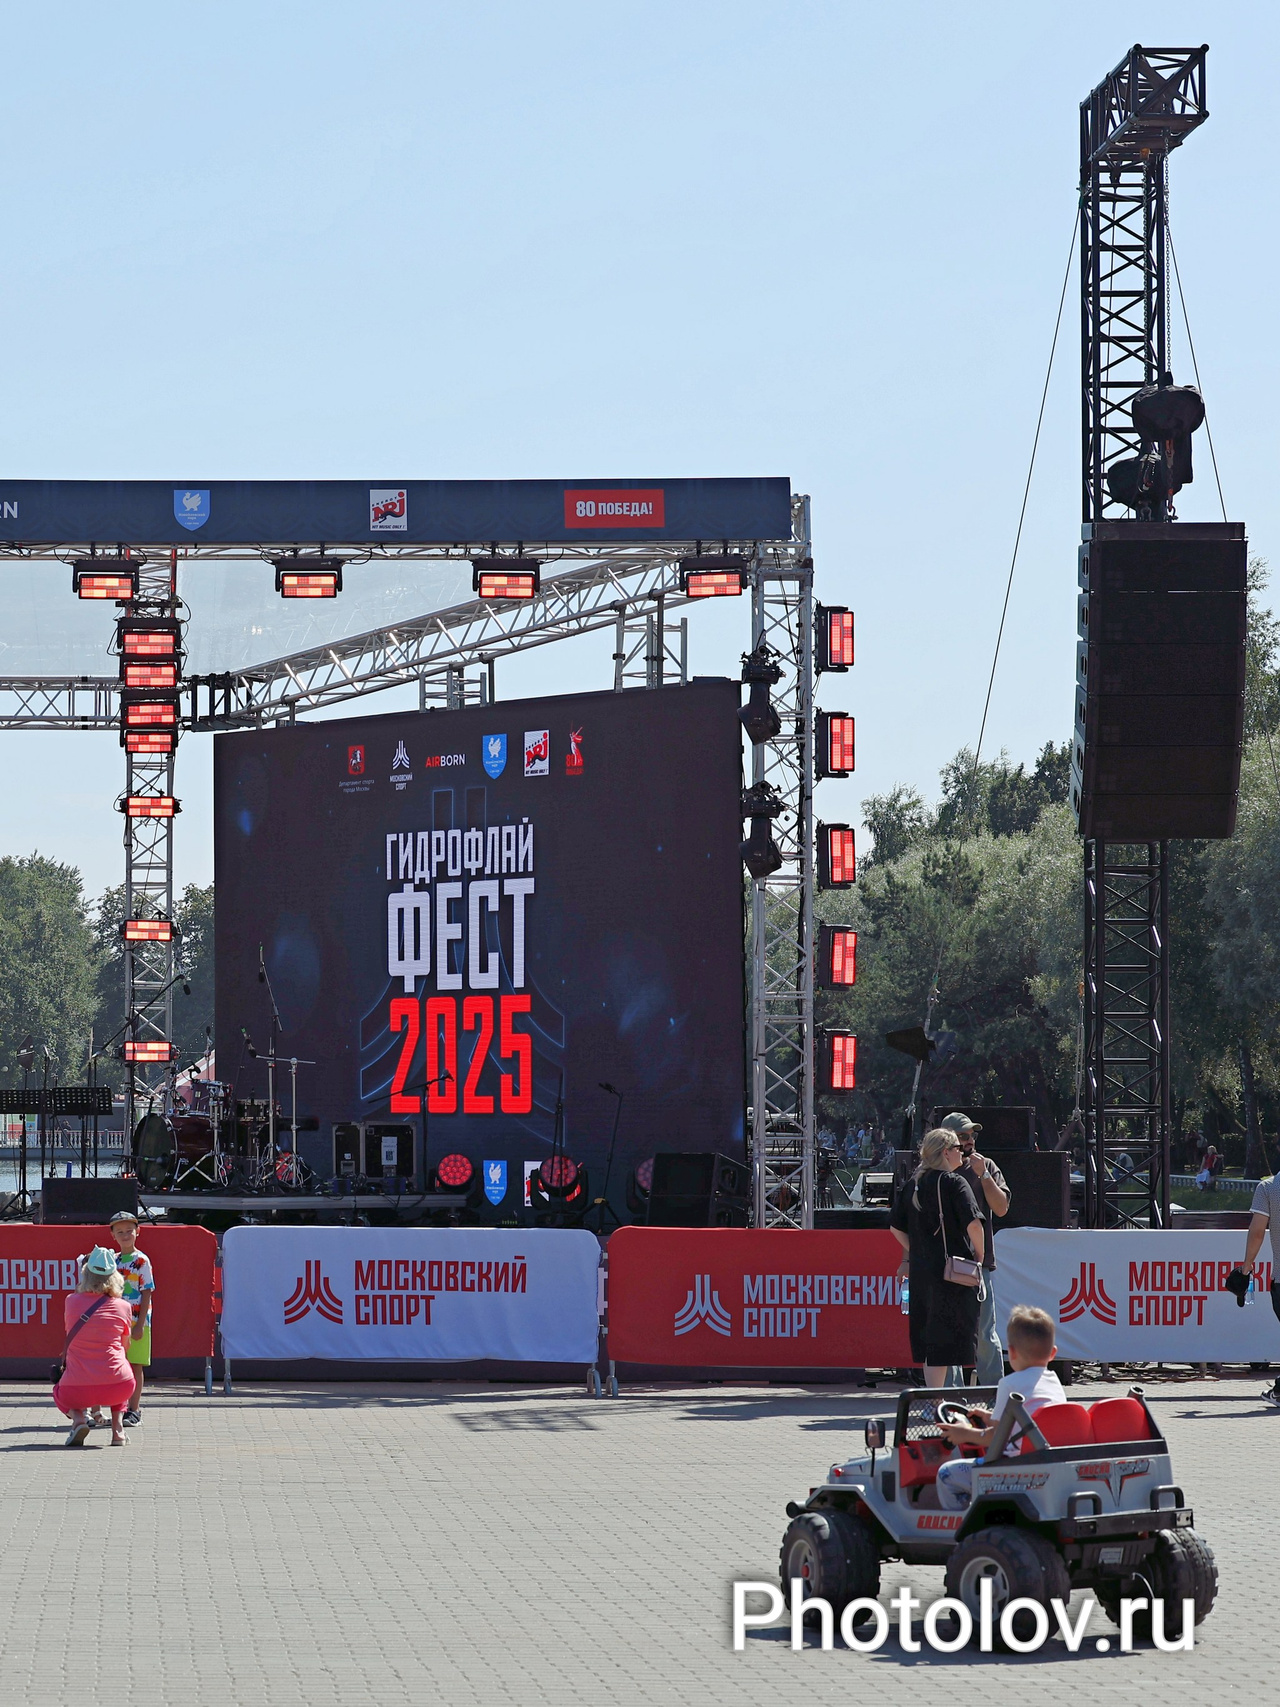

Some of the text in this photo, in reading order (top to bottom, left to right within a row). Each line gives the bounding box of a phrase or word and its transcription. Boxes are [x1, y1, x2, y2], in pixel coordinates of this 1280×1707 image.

[575, 501, 653, 517] 80 ПОБЕДА!
[425, 753, 466, 769] AIRBORN
[386, 817, 534, 884] ГИДРОФЛАЙ
[387, 877, 535, 993] ФЕСТ
[389, 995, 532, 1114] 2025
[354, 1256, 527, 1294] МОСКОВСКИЙ
[355, 1294, 435, 1326] СПОРТ
[743, 1308, 821, 1338] СПОРТ
[1129, 1295, 1208, 1326] СПОРТ
